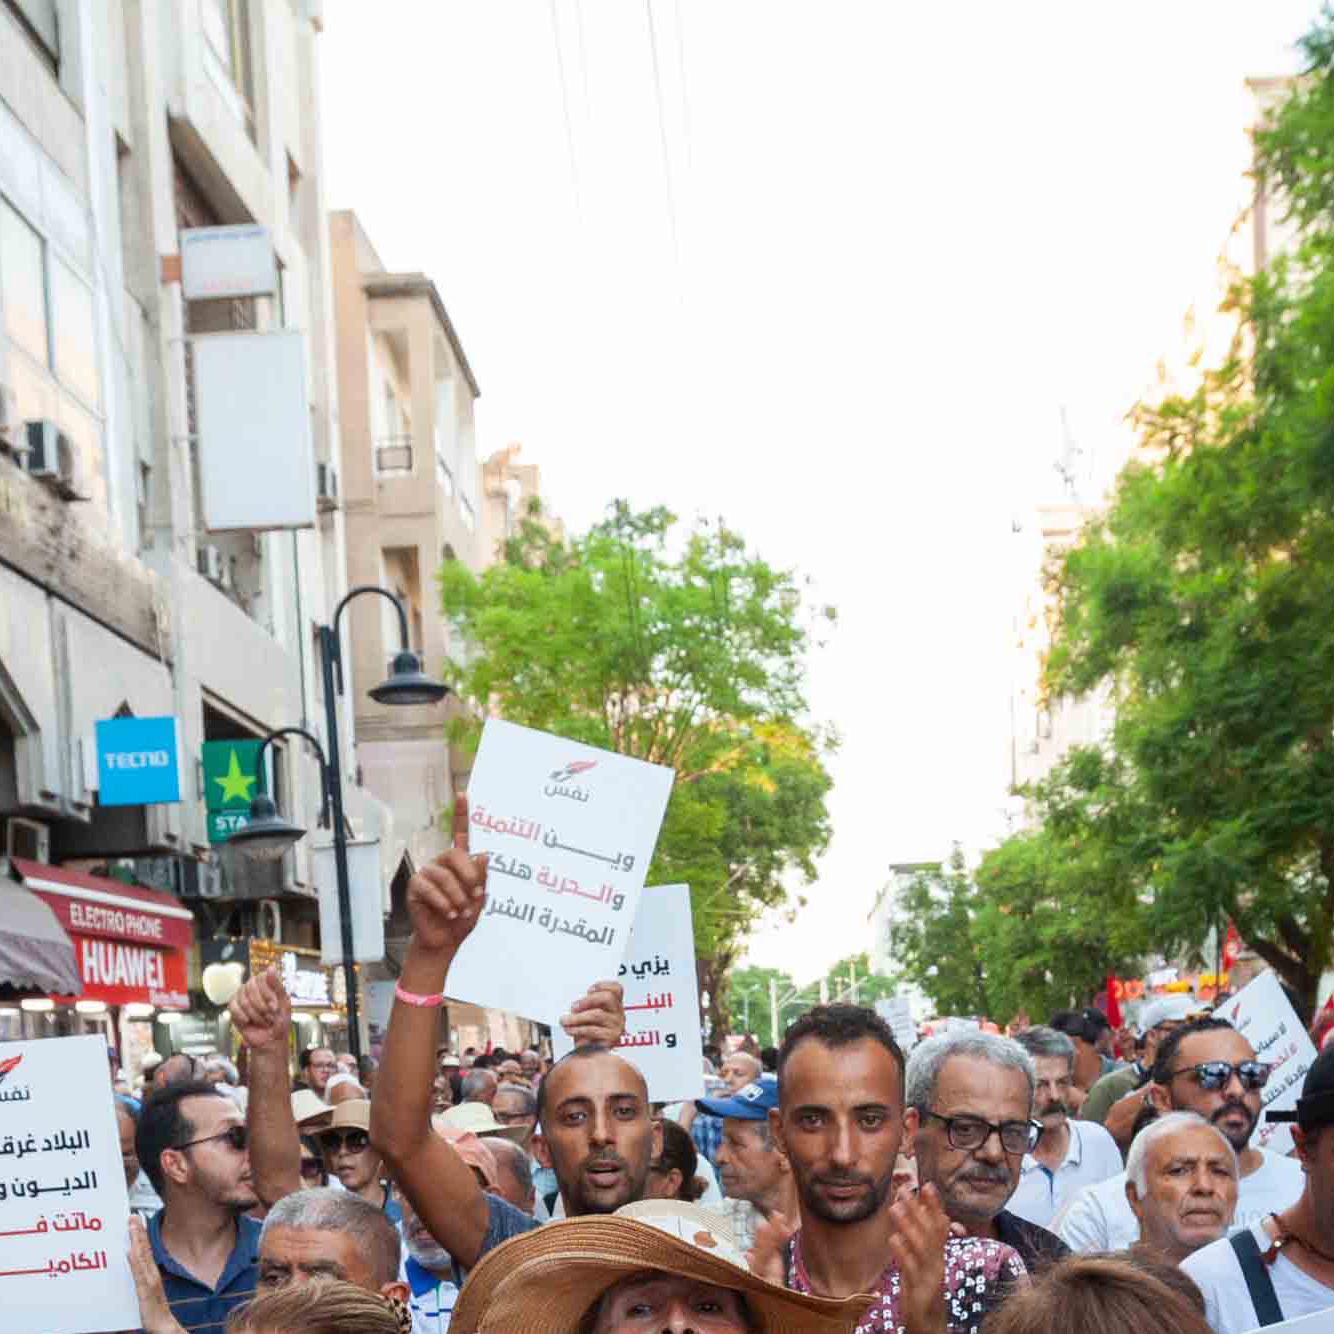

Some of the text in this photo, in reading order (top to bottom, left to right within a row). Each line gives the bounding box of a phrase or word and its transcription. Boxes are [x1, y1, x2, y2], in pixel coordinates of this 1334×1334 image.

[105, 750, 169, 769] TECNO
[543, 783, 590, 802] نفس
[215, 815, 248, 832] STA
[470, 804, 541, 841] التنمية
[70, 903, 164, 939] ELECTRO PHONE
[486, 896, 615, 946] المقدرة الشر
[82, 939, 164, 990] HUAWEI
[632, 955, 670, 980] يزي
[623, 992, 673, 1014] البن
[41, 1130, 90, 1155] البلاد
[11, 1171, 97, 1198] الديون
[52, 1212, 102, 1232] ماتت
